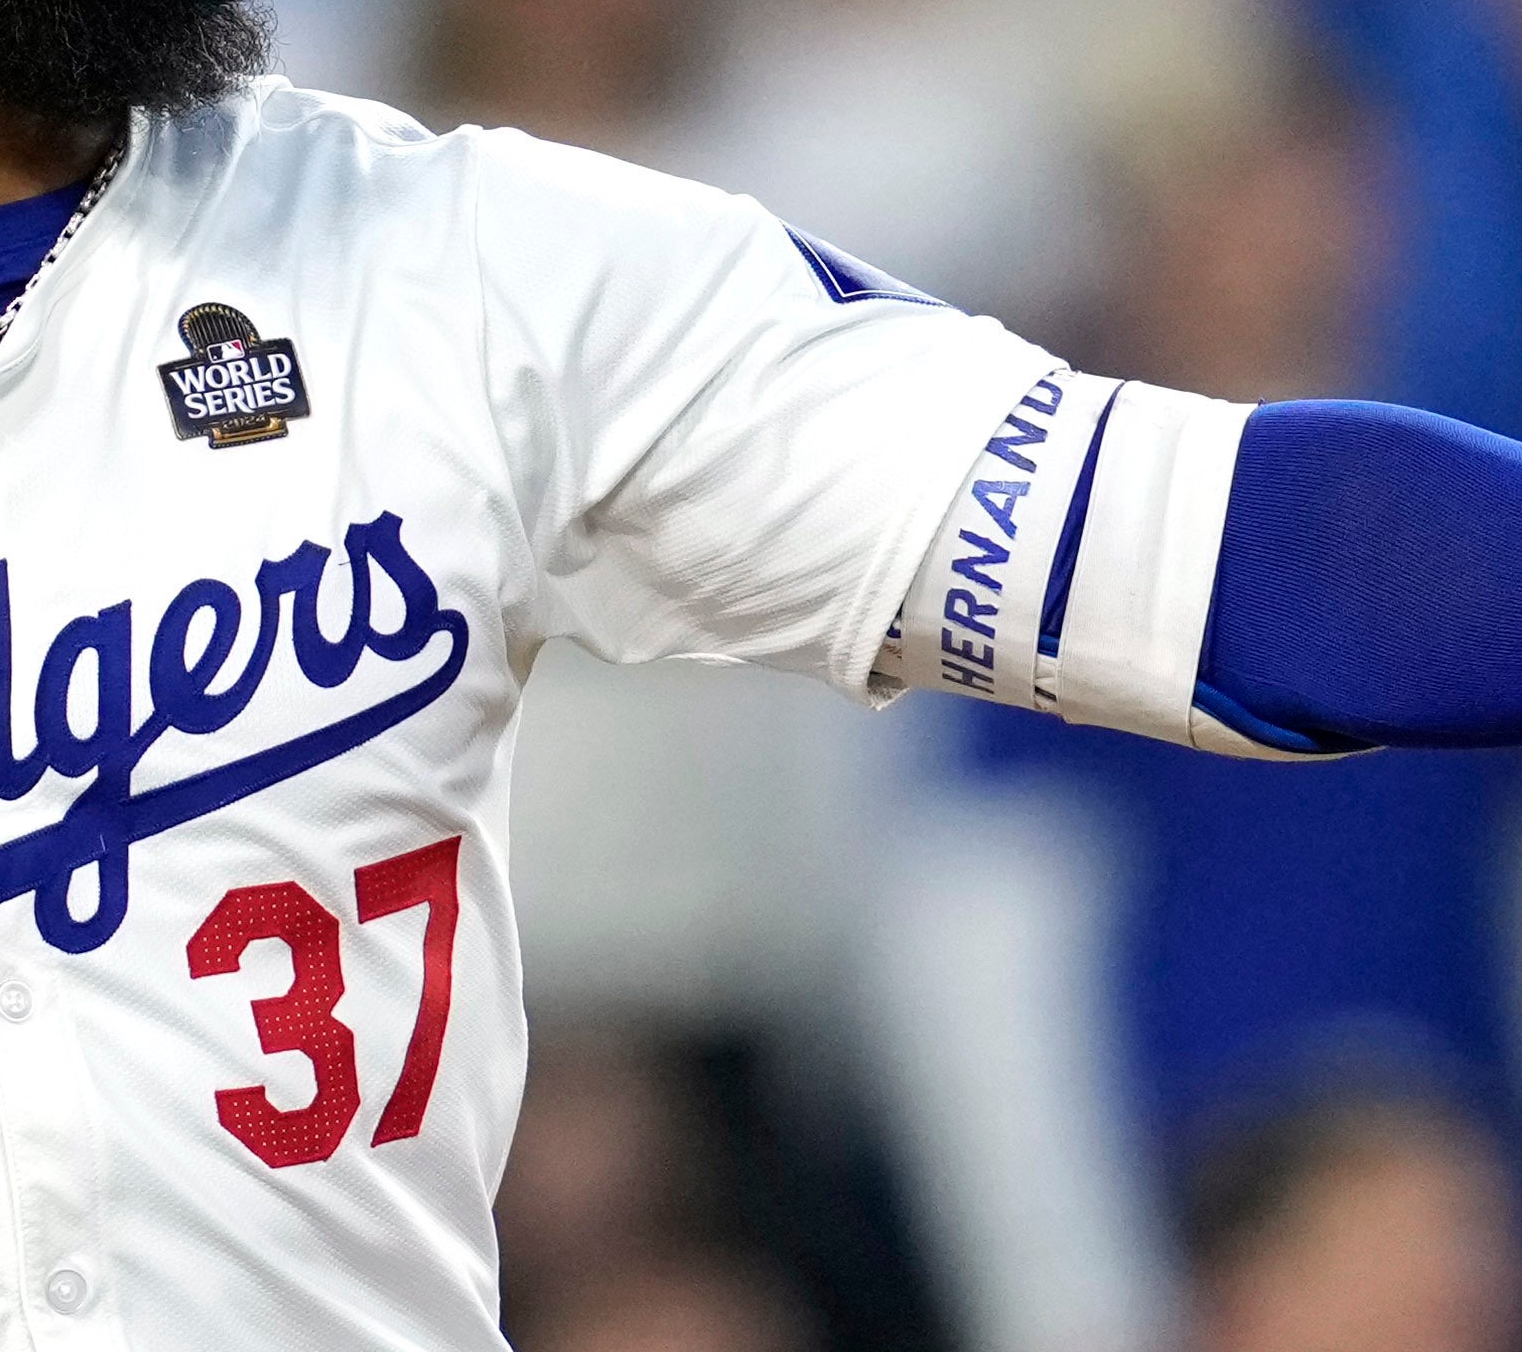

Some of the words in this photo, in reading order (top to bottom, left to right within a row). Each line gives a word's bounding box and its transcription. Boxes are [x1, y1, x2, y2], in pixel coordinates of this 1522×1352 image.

[169, 353, 292, 396] WORLD
[184, 377, 296, 419] SERIES
[941, 369, 1064, 695] HERNAND
[186, 834, 462, 1169] 37
